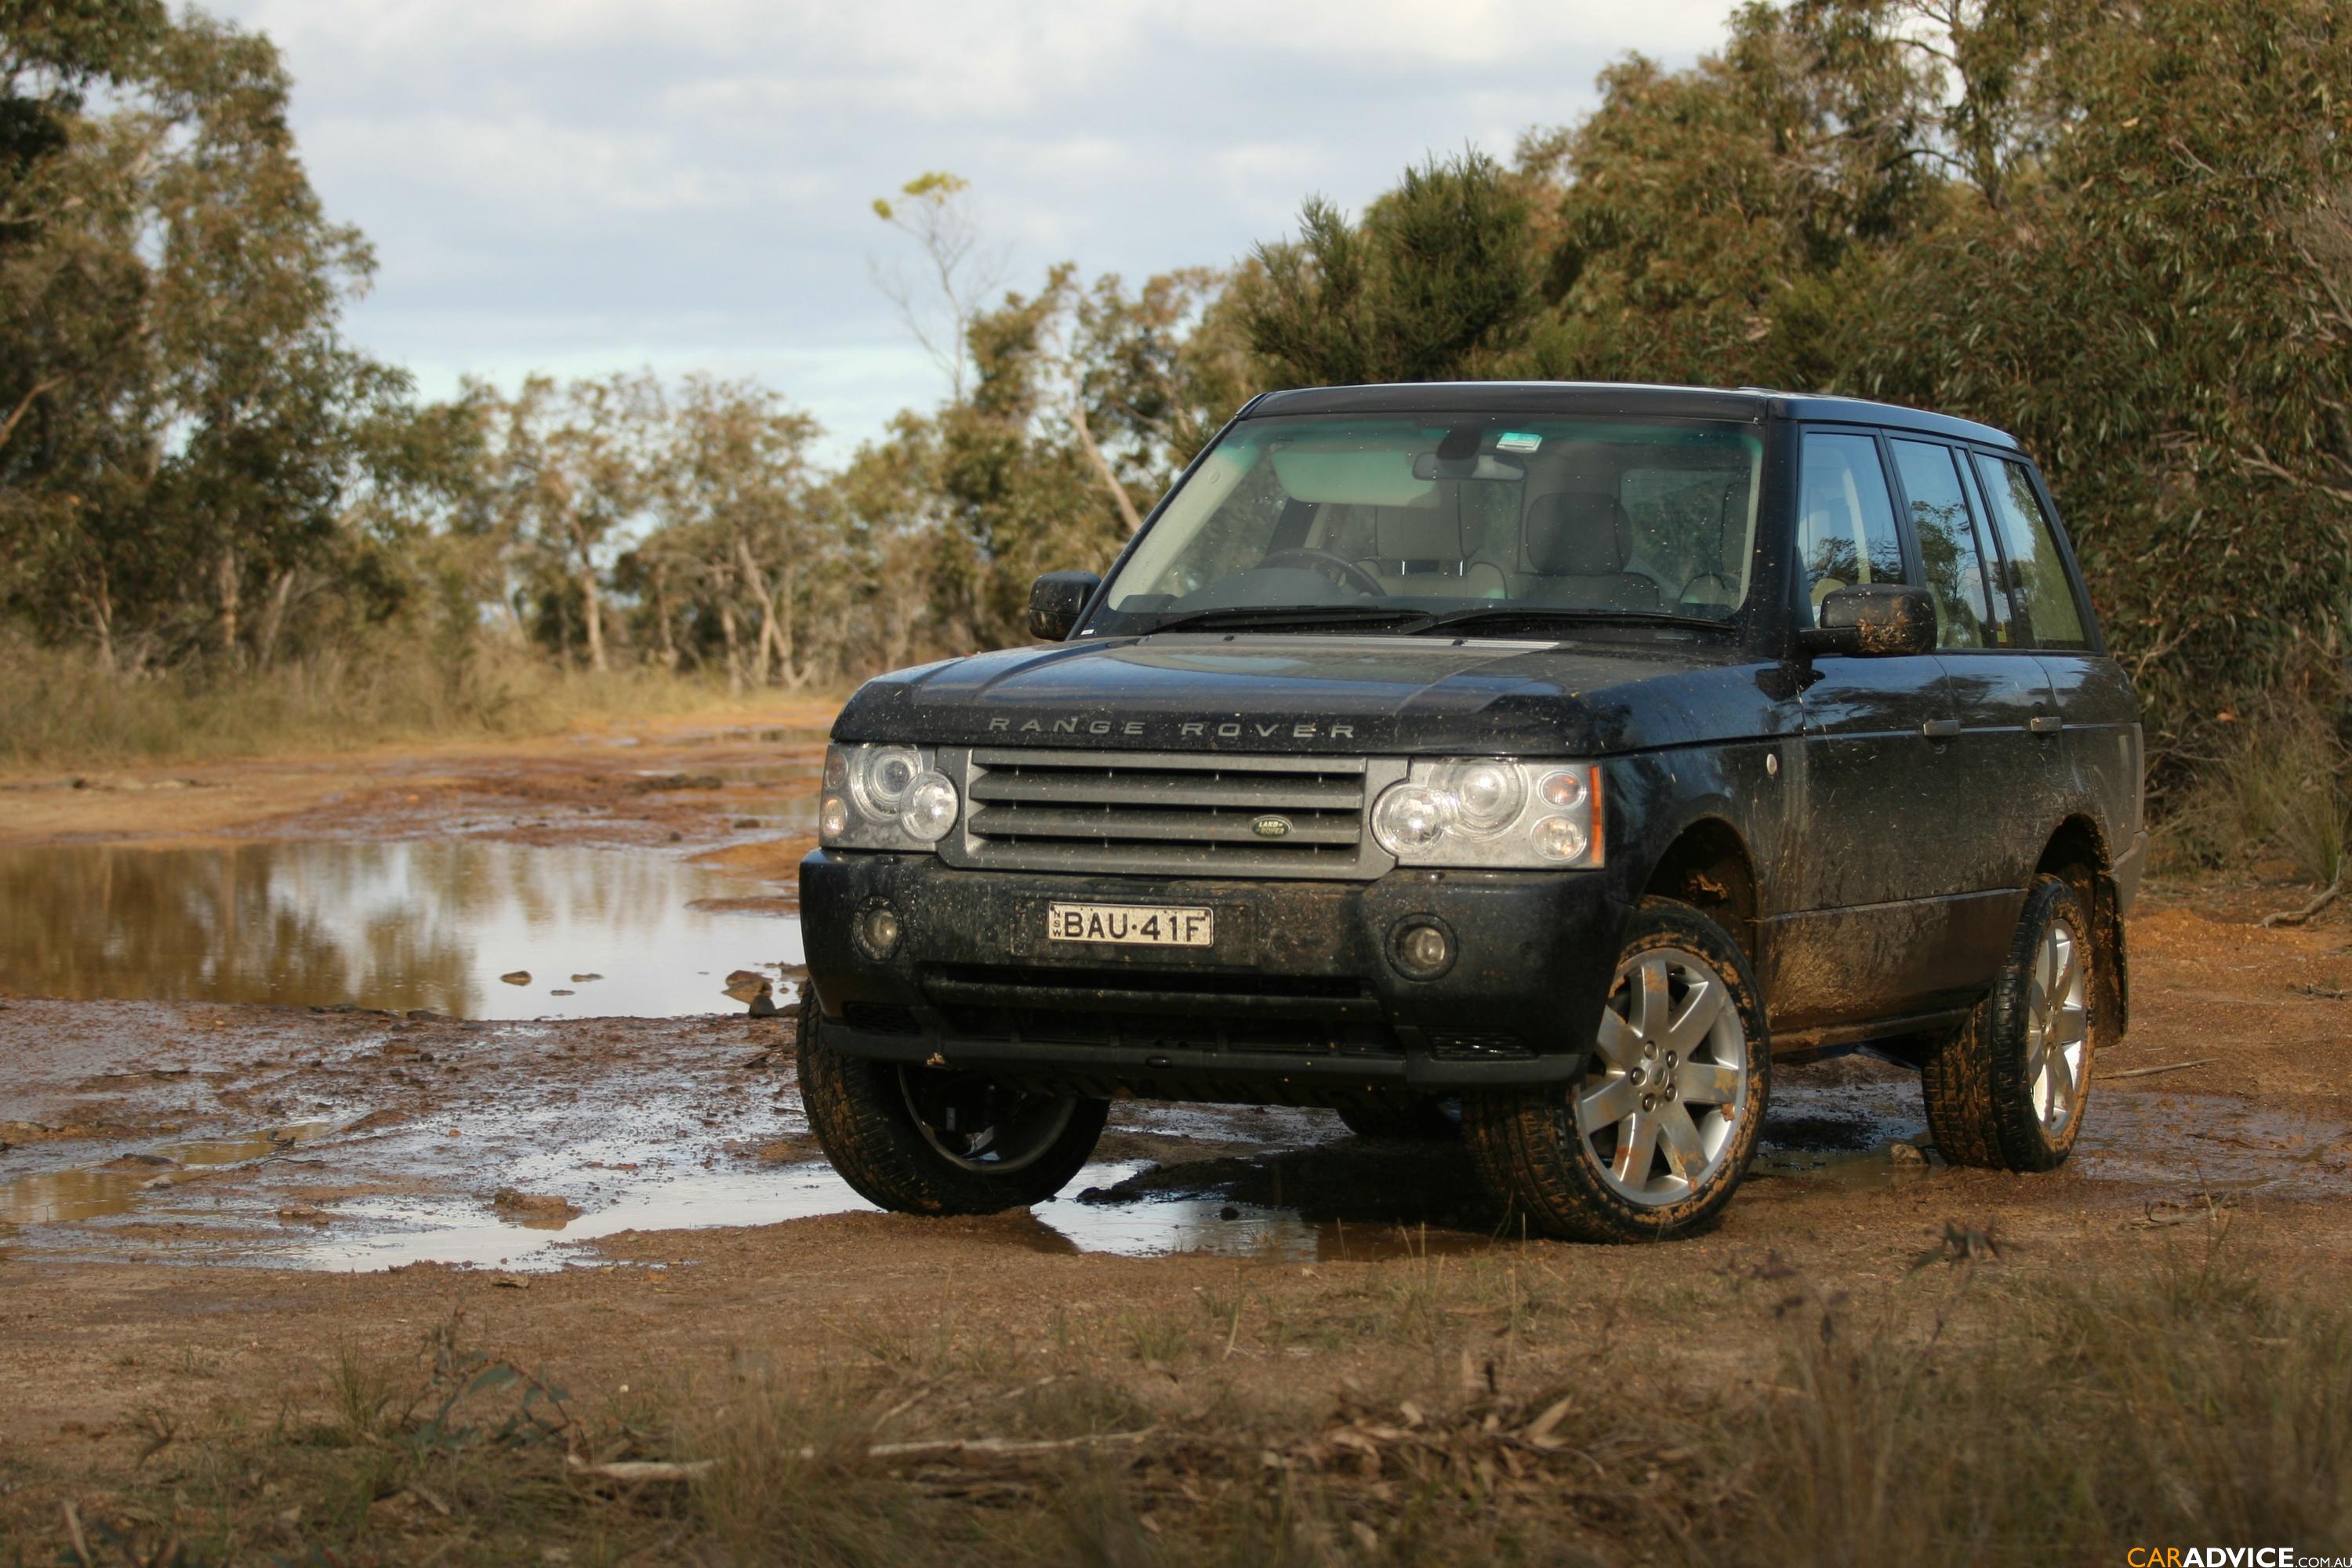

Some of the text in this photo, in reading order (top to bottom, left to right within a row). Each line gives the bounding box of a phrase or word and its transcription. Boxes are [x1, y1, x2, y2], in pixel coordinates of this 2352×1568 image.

[988, 717, 1354, 739] RANGE ROVER
[1053, 910, 1062, 937] NSW
